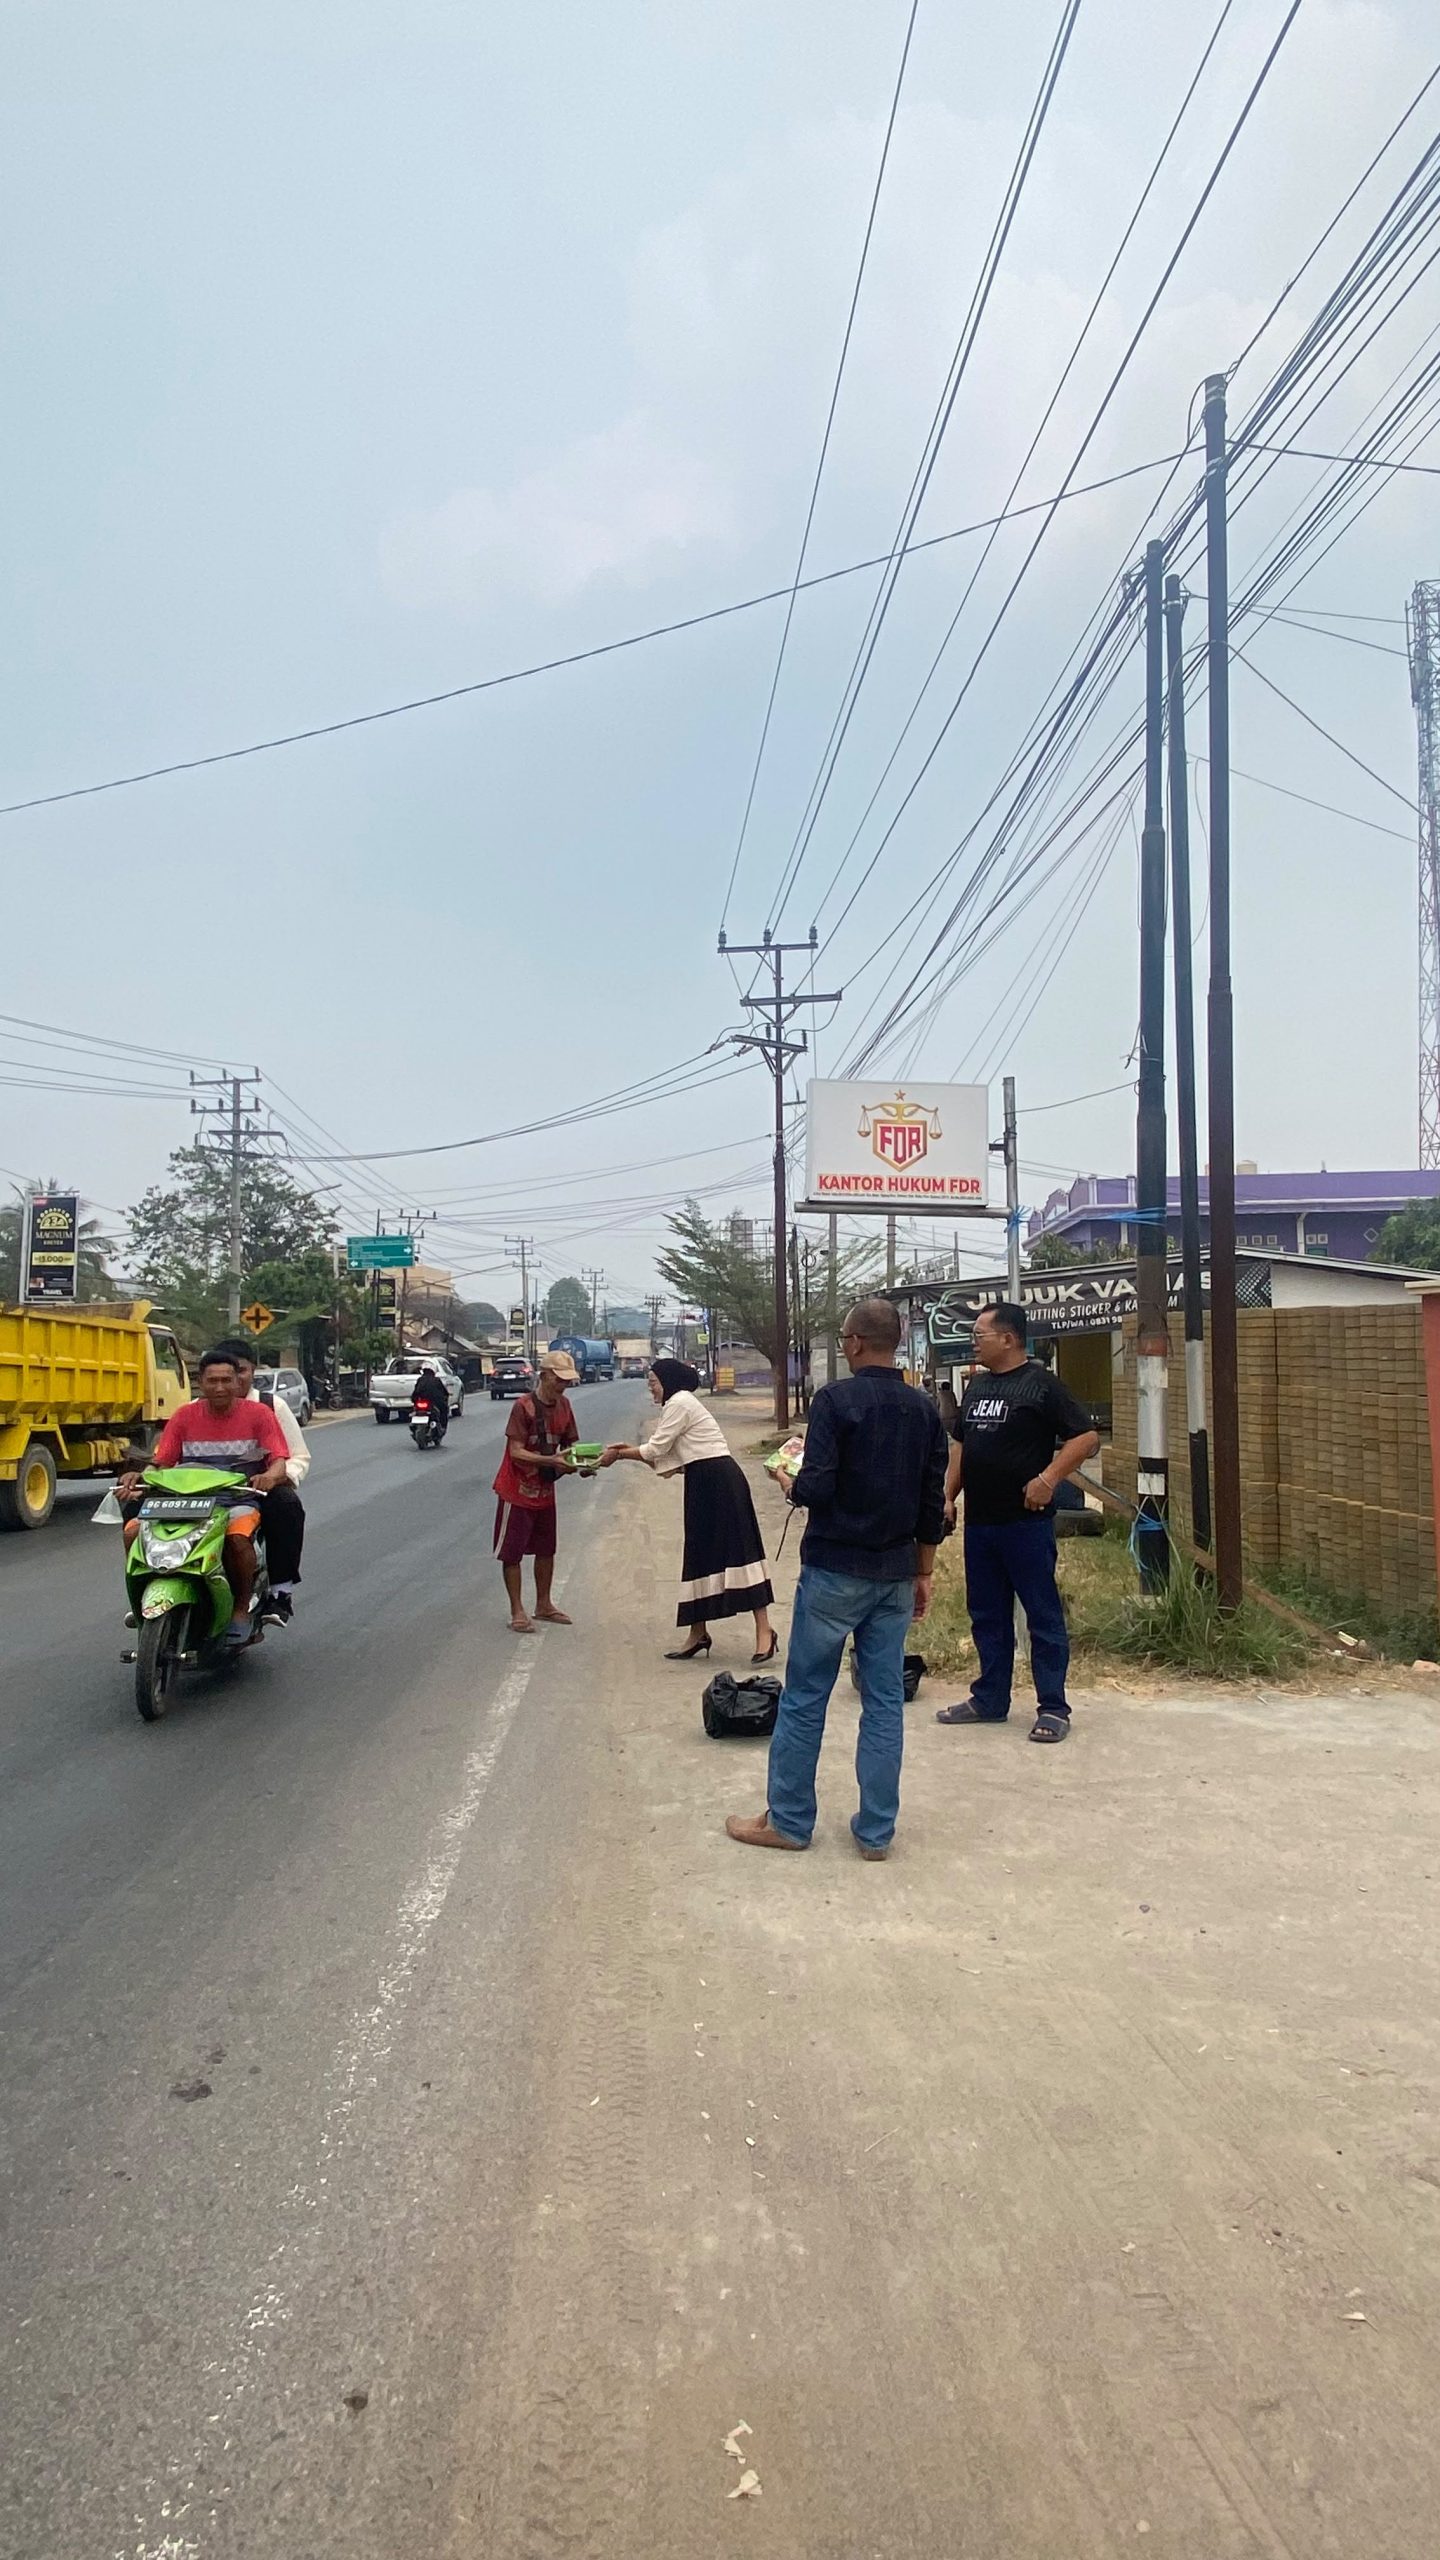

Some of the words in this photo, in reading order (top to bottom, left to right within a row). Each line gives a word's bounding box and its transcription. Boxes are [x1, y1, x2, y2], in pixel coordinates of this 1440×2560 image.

[879, 1126, 921, 1165] FDR
[818, 1175, 883, 1191] KANTOR
[888, 1177, 945, 1192] HUKUM
[949, 1179, 980, 1193] FDR
[35, 1230, 73, 1239] MAGNUM
[1070, 1302, 1112, 1318] STICKER
[972, 1399, 1005, 1417] JEAN
